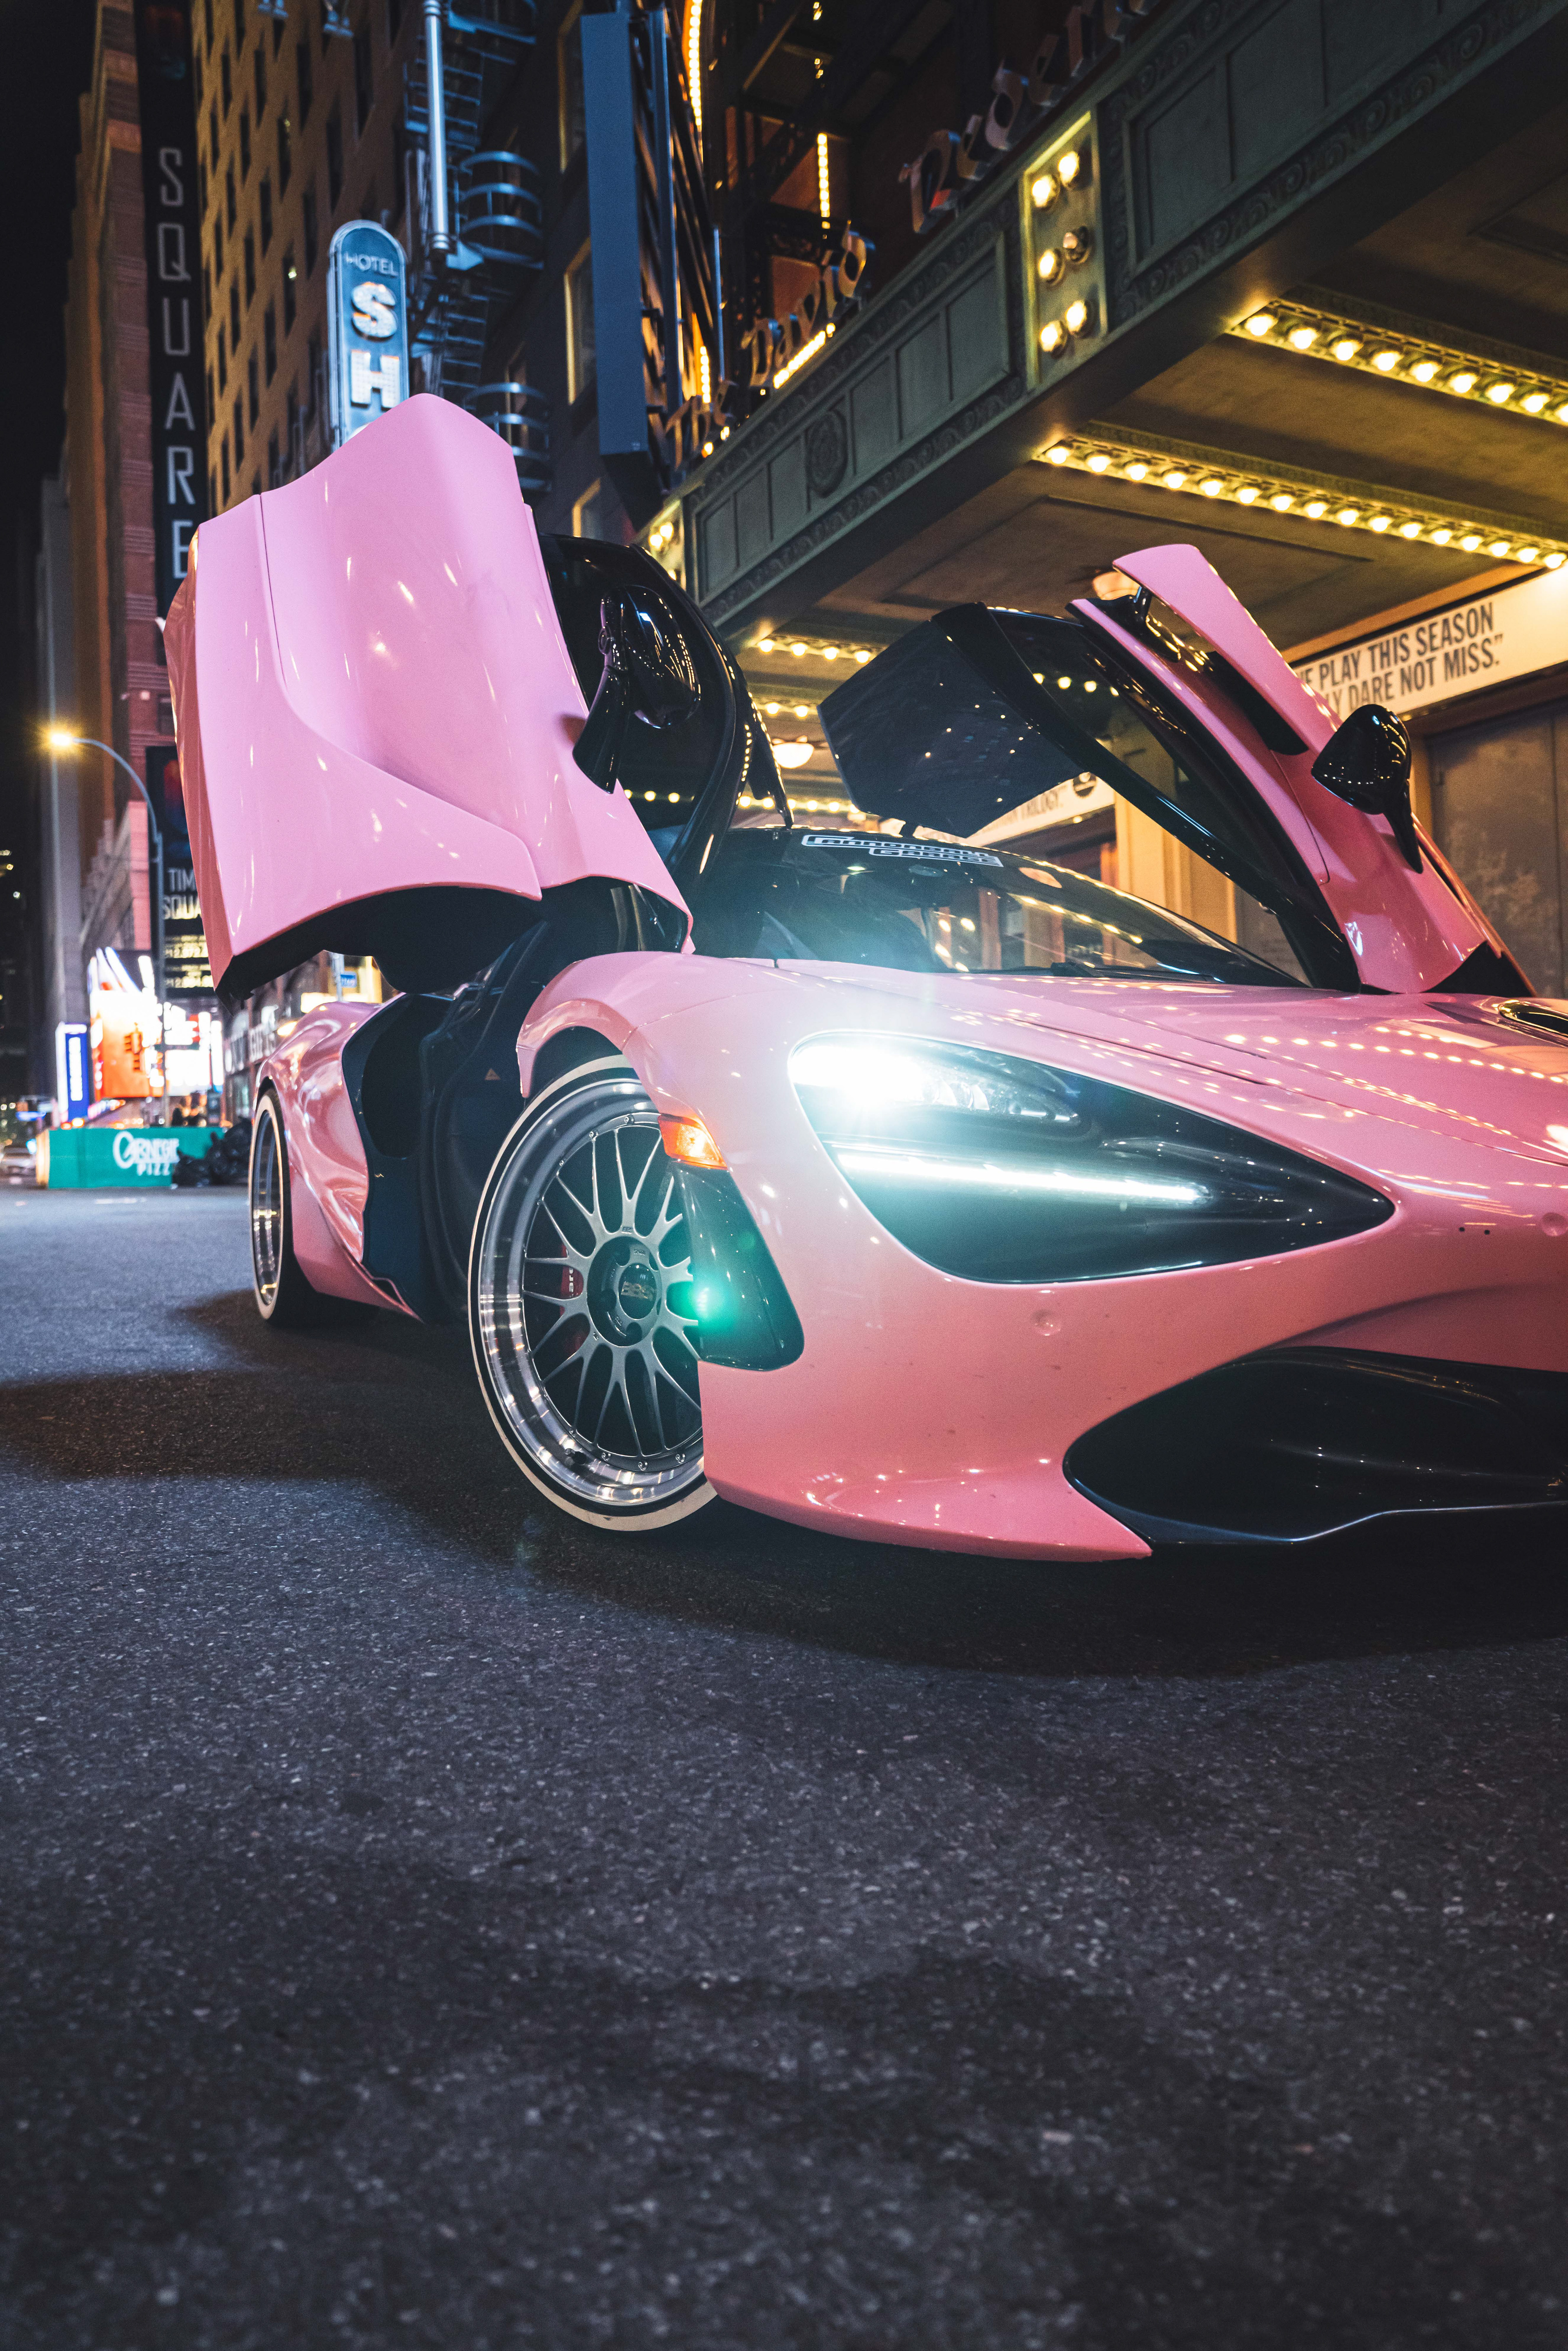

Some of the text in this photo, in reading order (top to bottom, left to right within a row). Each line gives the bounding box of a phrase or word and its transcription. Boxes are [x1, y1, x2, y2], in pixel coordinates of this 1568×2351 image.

[344, 251, 399, 276] HOTEL
[156, 147, 196, 579] SQUARE
[350, 282, 399, 438] SH
[1319, 650, 1361, 690] PLAY
[1368, 633, 1410, 673] THIS
[1416, 602, 1493, 656] SEASON
[1348, 671, 1395, 711] DARE
[1400, 656, 1437, 696] NOT
[167, 867, 196, 892] TIM
[137, 1163, 171, 1176] PIZZ
